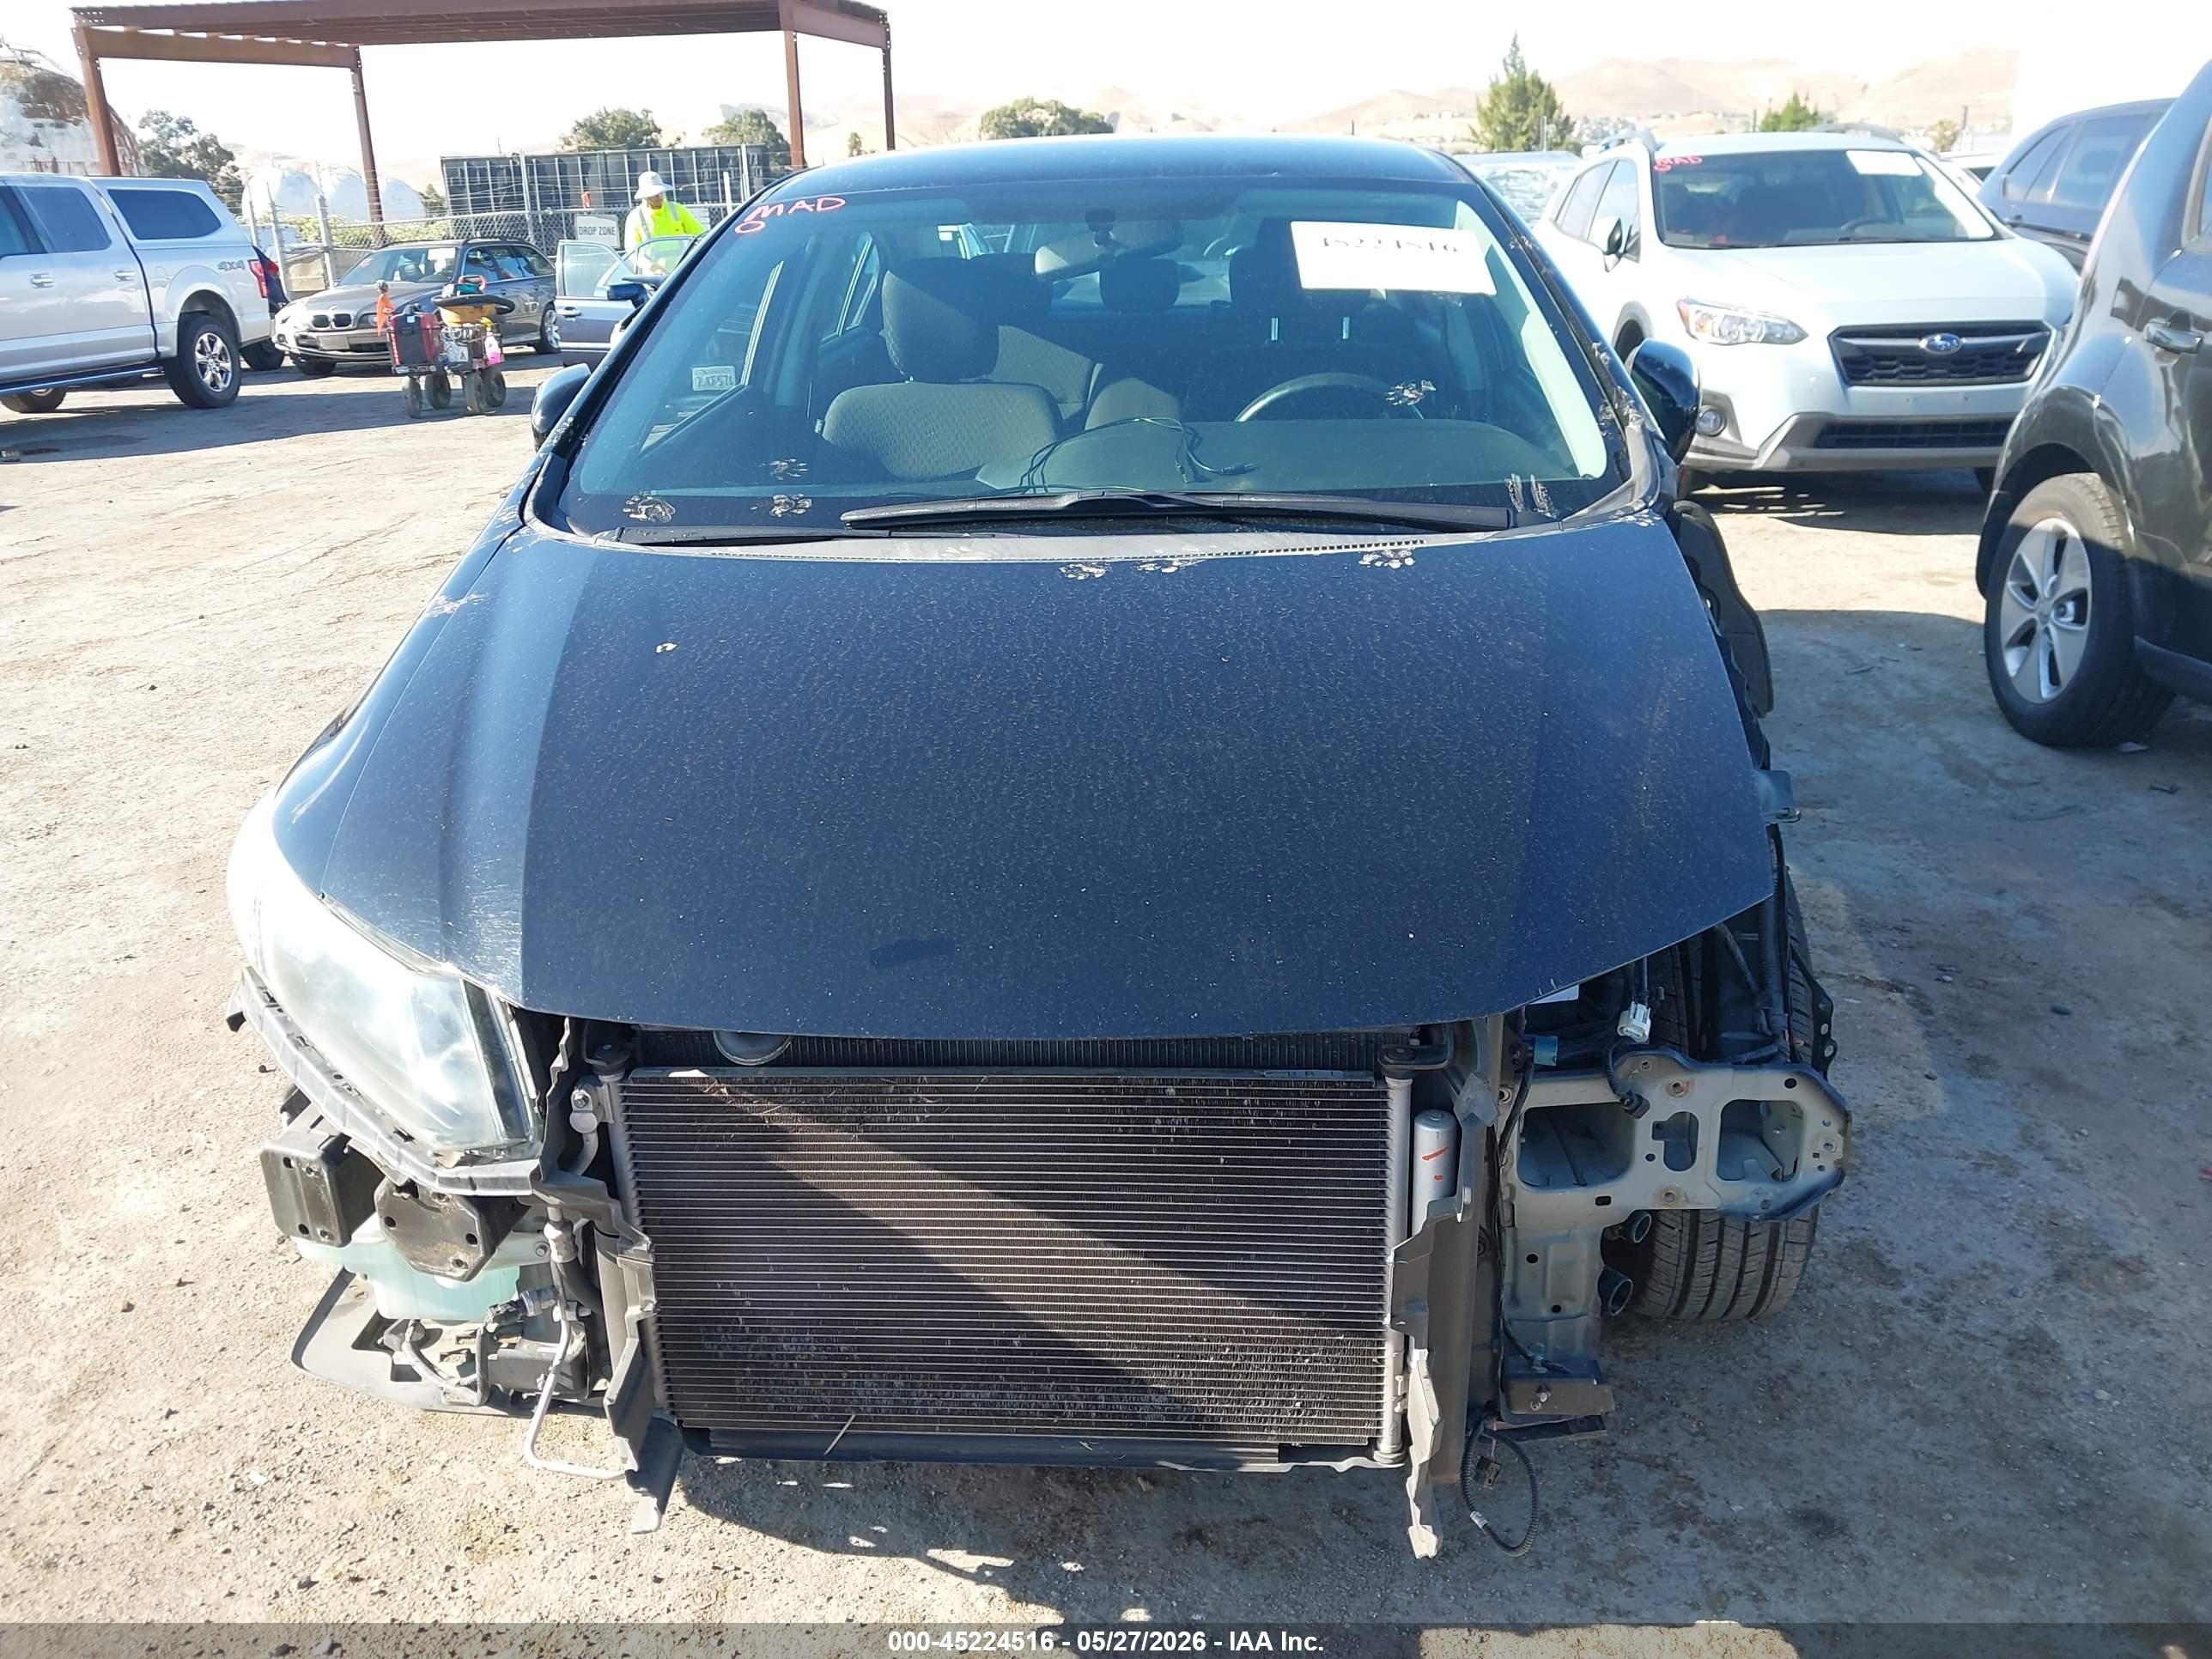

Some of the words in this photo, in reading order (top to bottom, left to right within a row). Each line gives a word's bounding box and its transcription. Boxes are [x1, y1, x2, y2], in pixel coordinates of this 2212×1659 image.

[744, 197, 846, 222] MAD
[578, 226, 597, 236] DROP
[598, 226, 617, 236] ZONE
